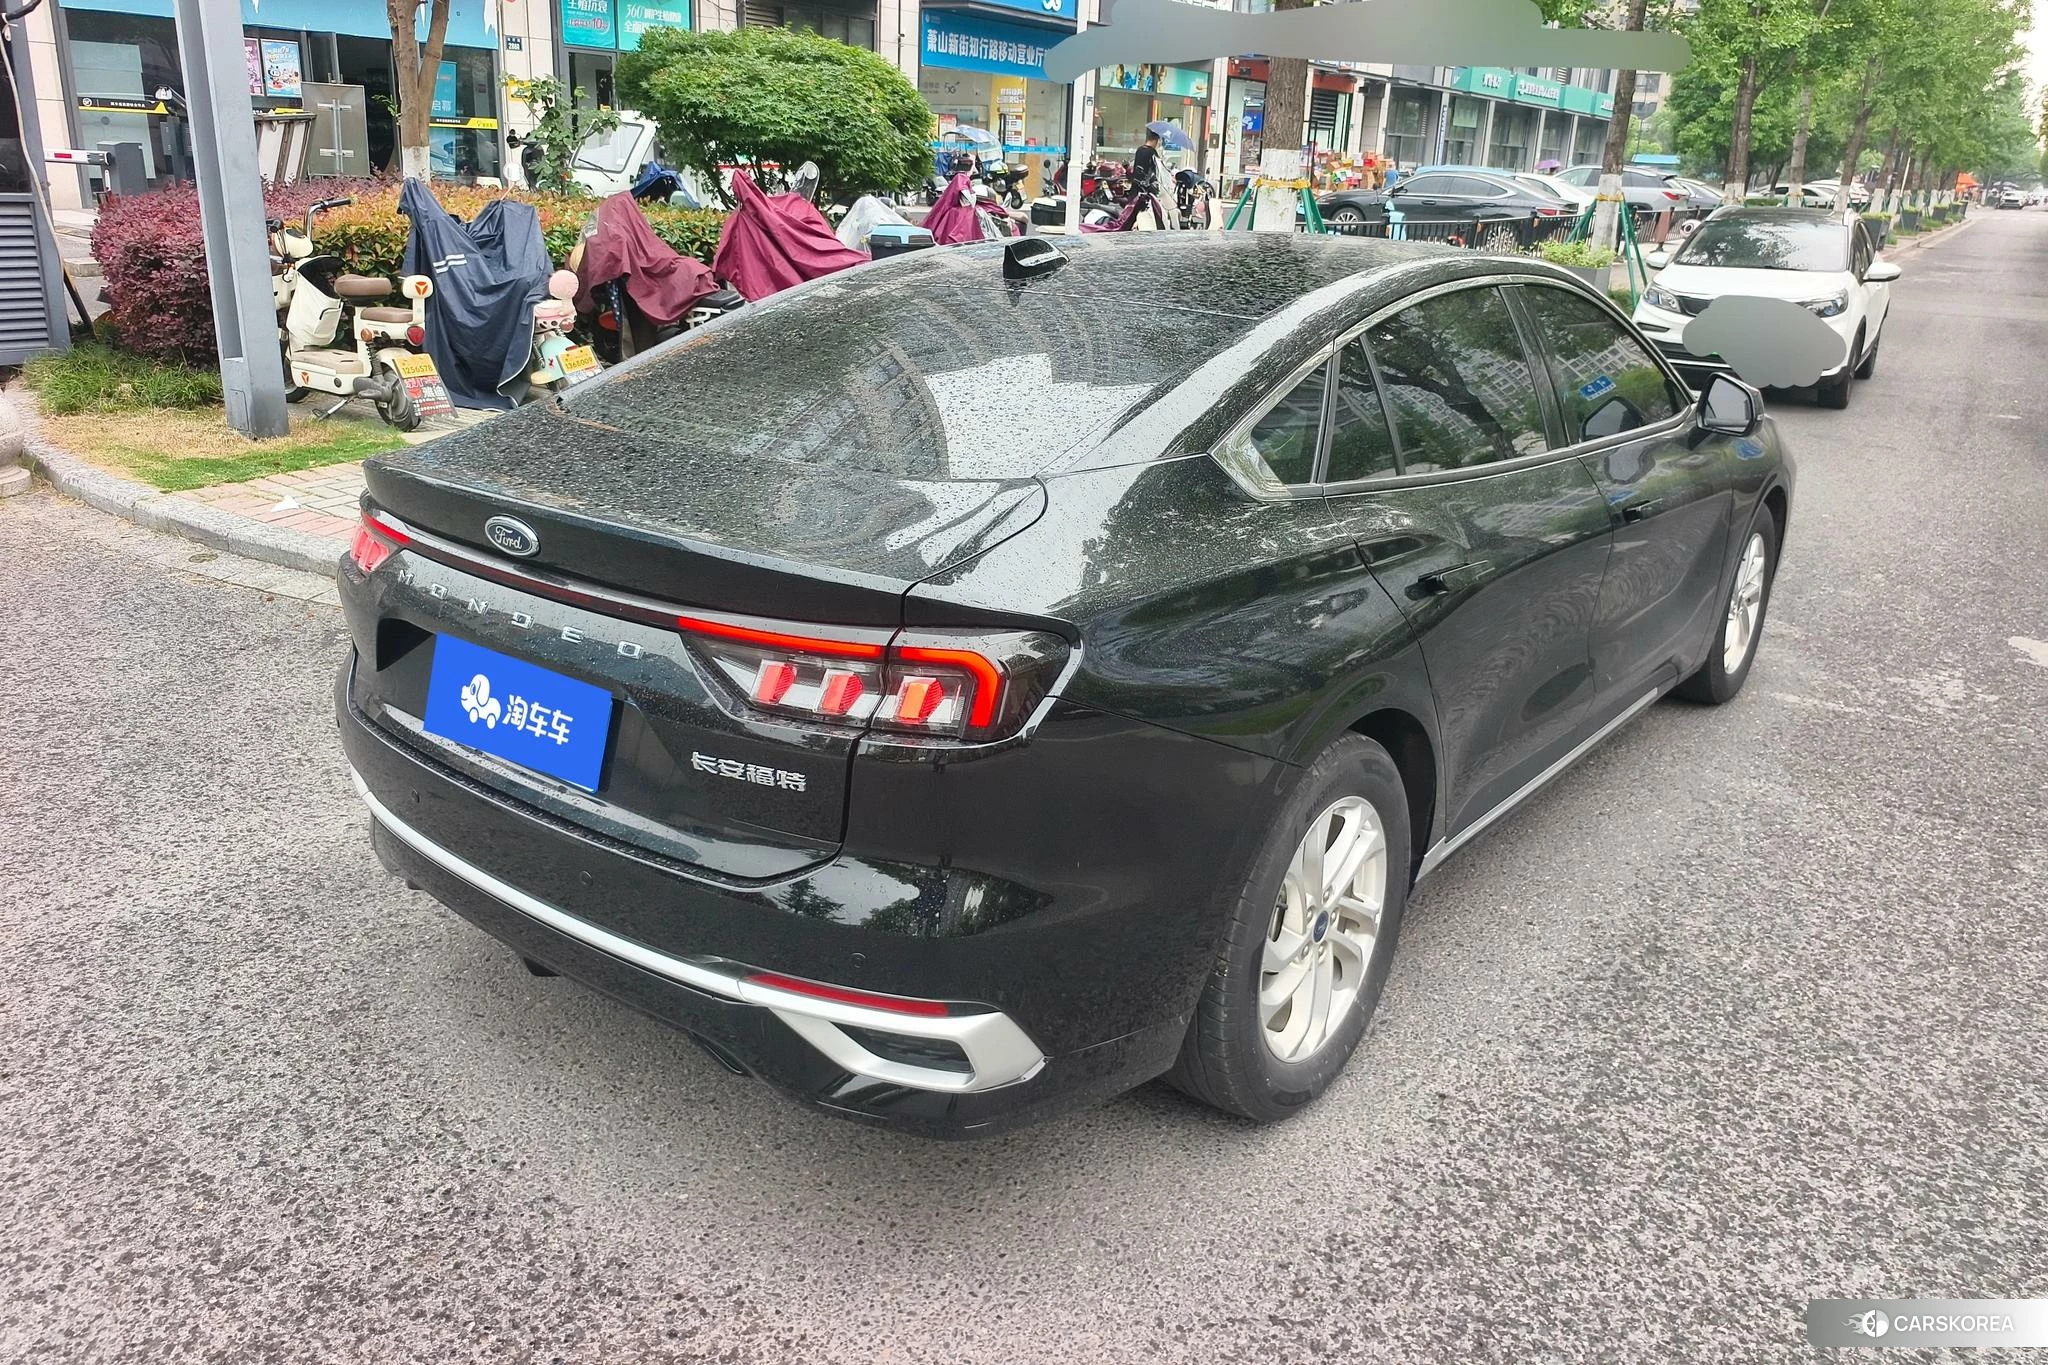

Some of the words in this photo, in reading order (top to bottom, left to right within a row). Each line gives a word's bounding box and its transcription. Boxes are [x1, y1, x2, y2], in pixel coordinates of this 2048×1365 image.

[927, 29, 1048, 67] 萧山新街知行路移动营业厅
[401, 364, 434, 375] 1256578
[494, 525, 523, 550] Ford
[398, 569, 645, 660] MONDEO
[691, 751, 807, 792] 长安福特
